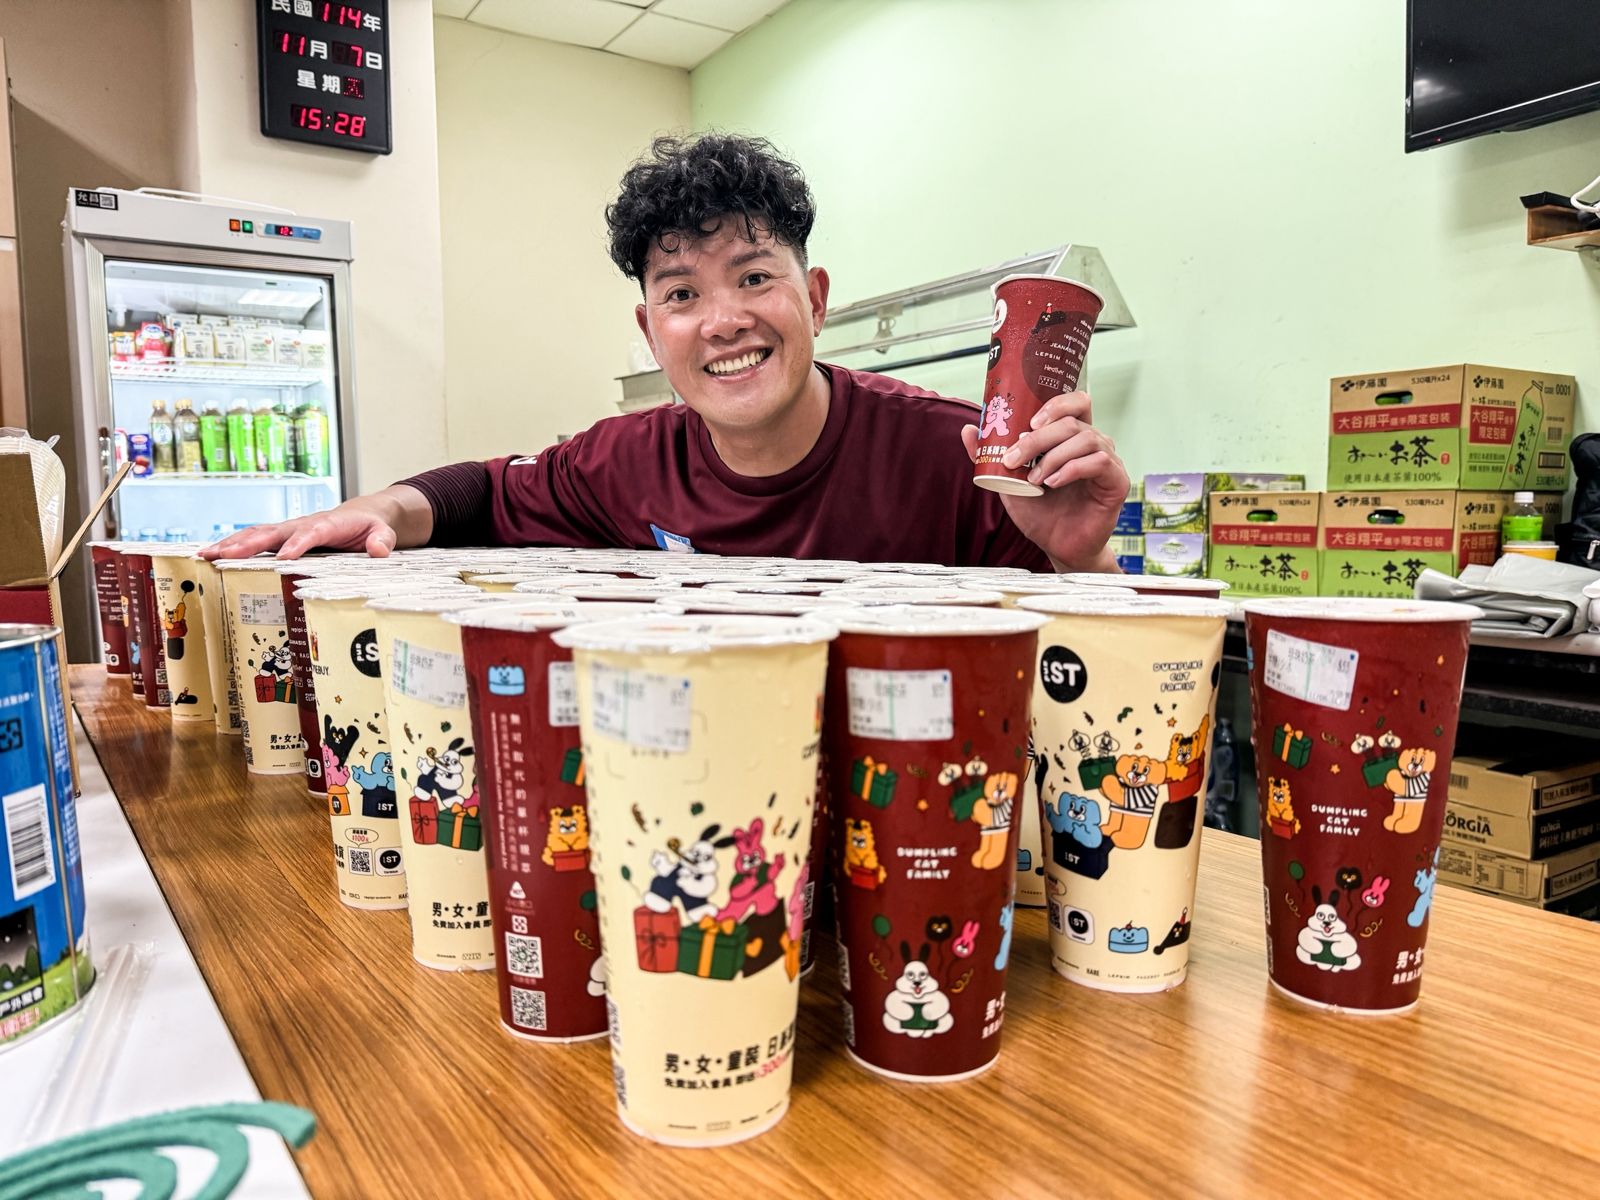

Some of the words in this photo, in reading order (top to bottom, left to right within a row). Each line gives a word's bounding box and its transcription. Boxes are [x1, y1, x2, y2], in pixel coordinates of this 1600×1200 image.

[300, 107, 366, 137] 15:28
[1356, 378, 1387, 389] 伊藤園
[1556, 384, 1571, 395] 0001
[365, 642, 380, 662] S
[1311, 804, 1368, 817] DUMPLING
[1326, 816, 1350, 826] CAT
[1319, 825, 1360, 836] FAMILY
[896, 847, 958, 858] DUMPLING
[913, 859, 940, 869] CAT
[906, 868, 951, 880] FAMILY
